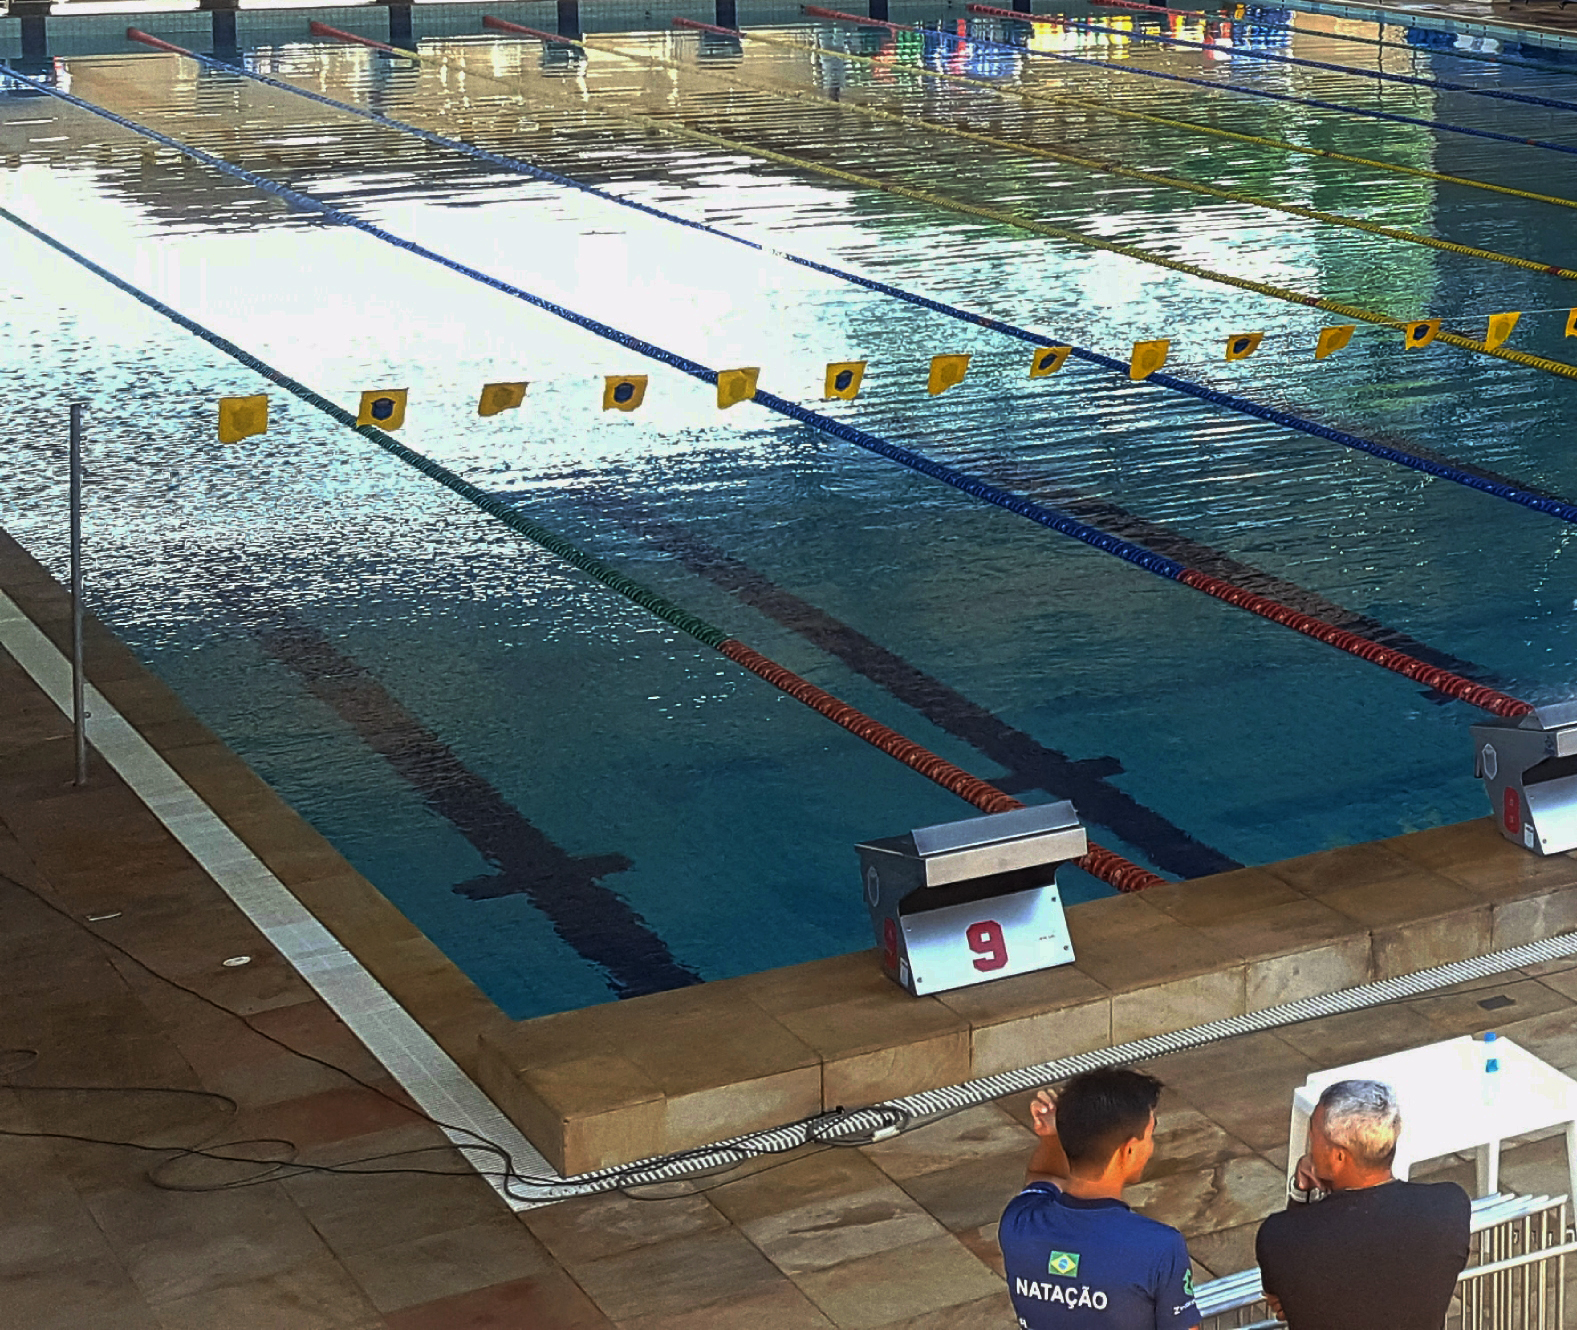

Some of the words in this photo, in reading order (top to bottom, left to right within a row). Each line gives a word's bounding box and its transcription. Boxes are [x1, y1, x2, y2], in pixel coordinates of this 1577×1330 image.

[1503, 786, 1521, 835] 8
[966, 920, 1009, 973] 9
[1015, 1276, 1109, 1310] NATAÇÃO
